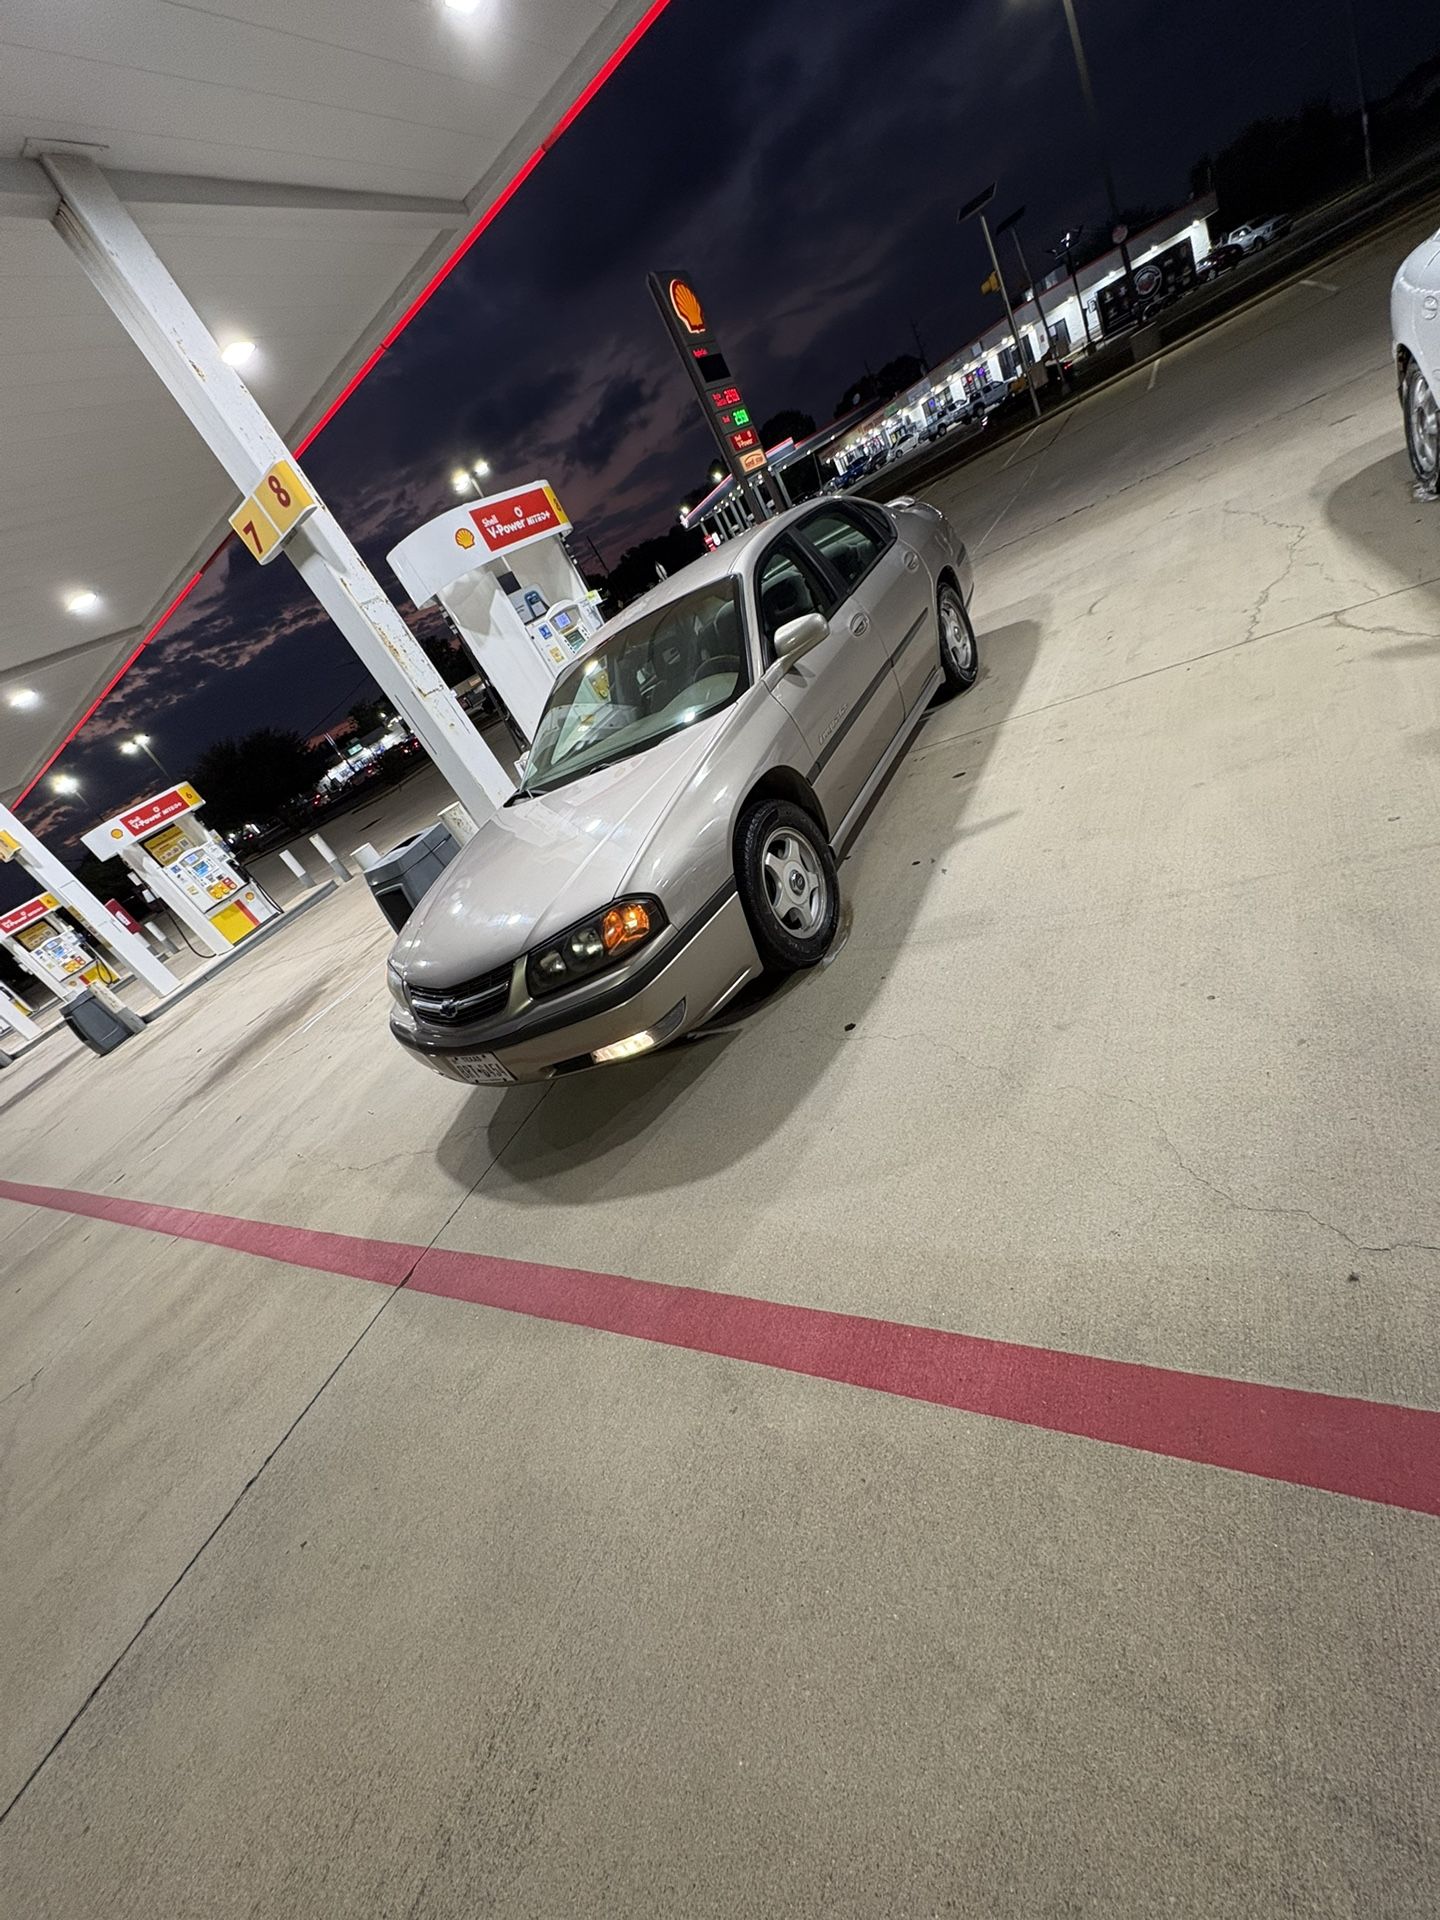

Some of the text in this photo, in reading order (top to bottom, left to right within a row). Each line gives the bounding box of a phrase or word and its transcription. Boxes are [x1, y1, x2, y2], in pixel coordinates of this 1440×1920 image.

[268, 475, 291, 508] 8
[481, 514, 499, 528] Shell
[486, 518, 526, 539] V-Power
[242, 520, 263, 554] 7
